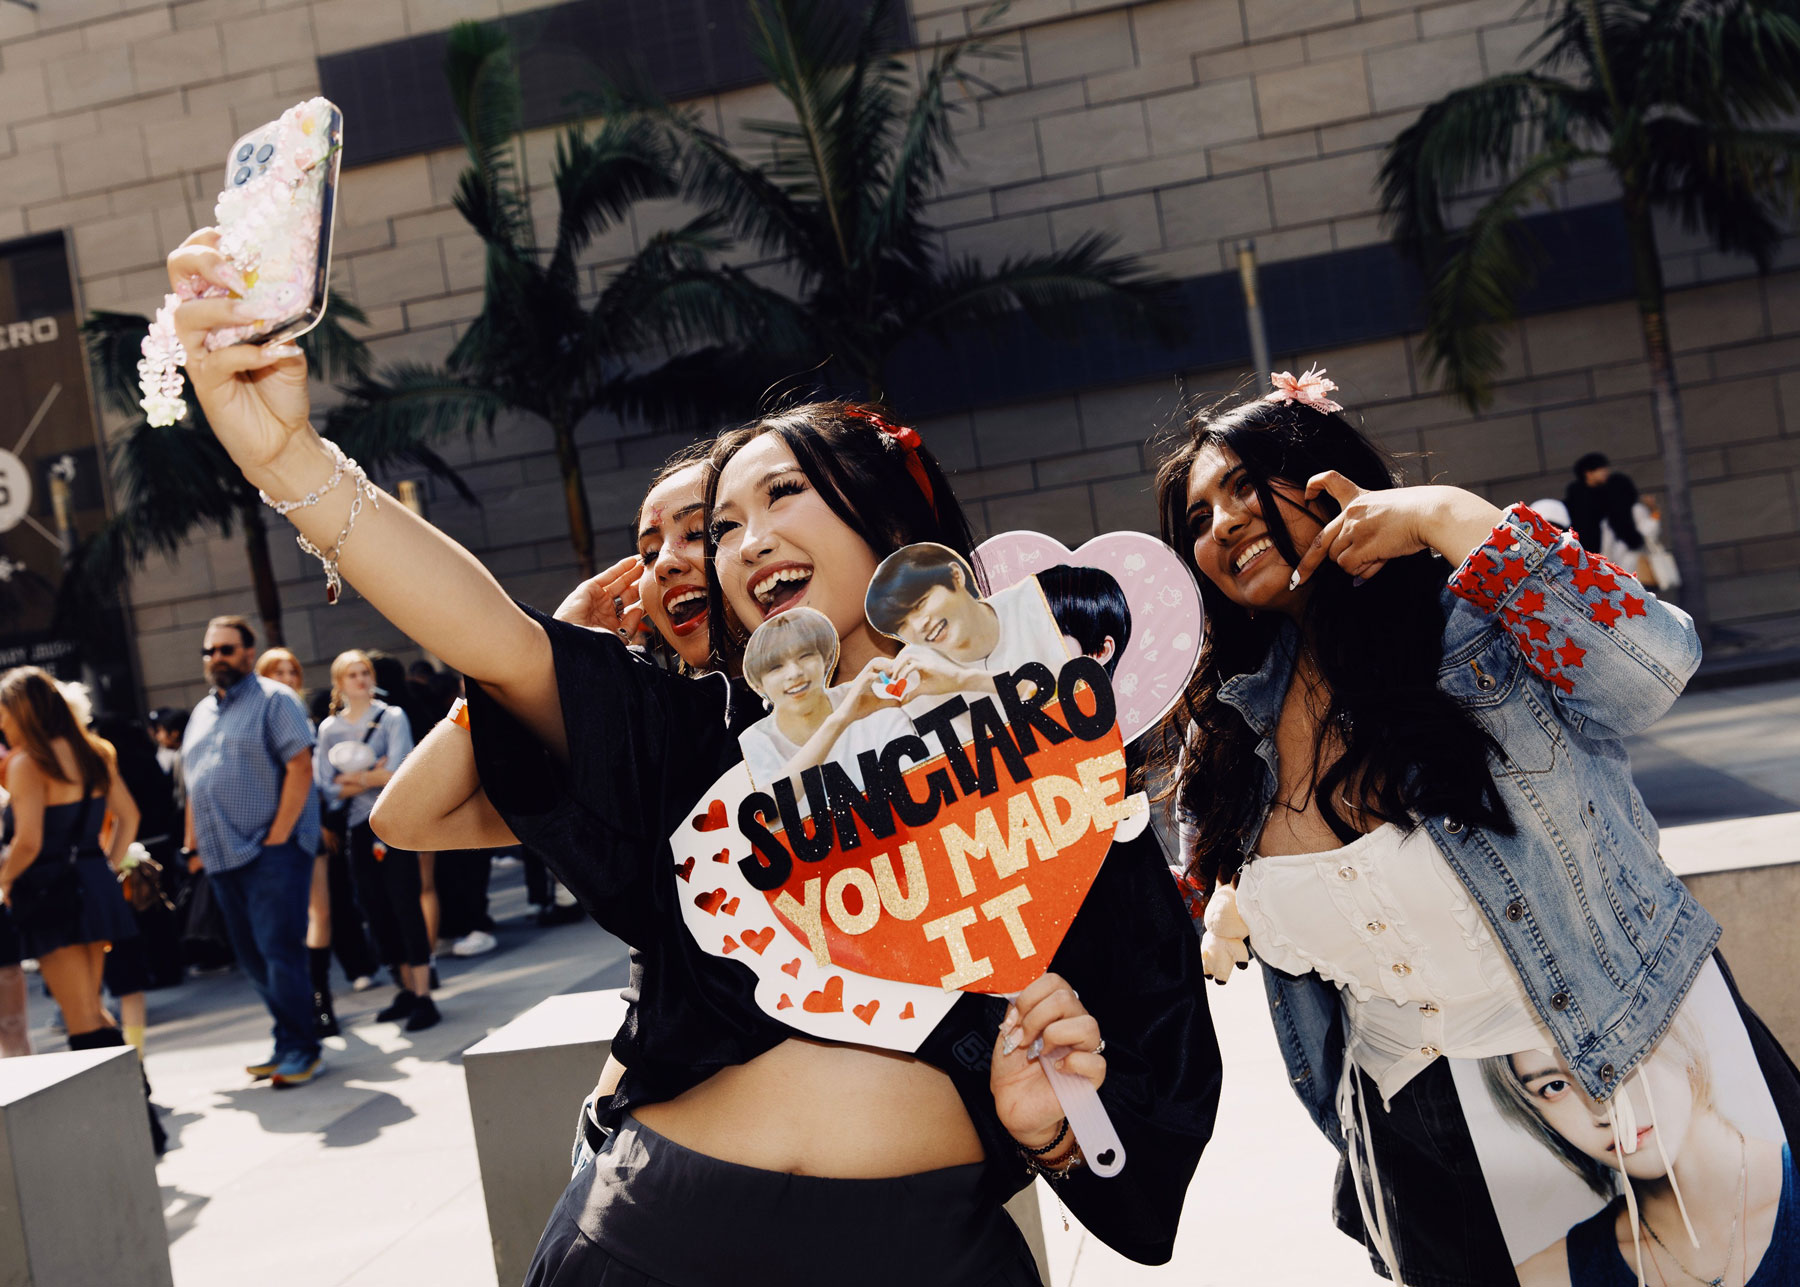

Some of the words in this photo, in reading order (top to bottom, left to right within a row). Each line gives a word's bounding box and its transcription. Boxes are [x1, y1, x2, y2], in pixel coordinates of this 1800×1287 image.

[737, 655, 1117, 891] SUNGTARO
[773, 841, 930, 968] YOU
[939, 749, 1145, 898] MADE
[922, 883, 1037, 993] IT
